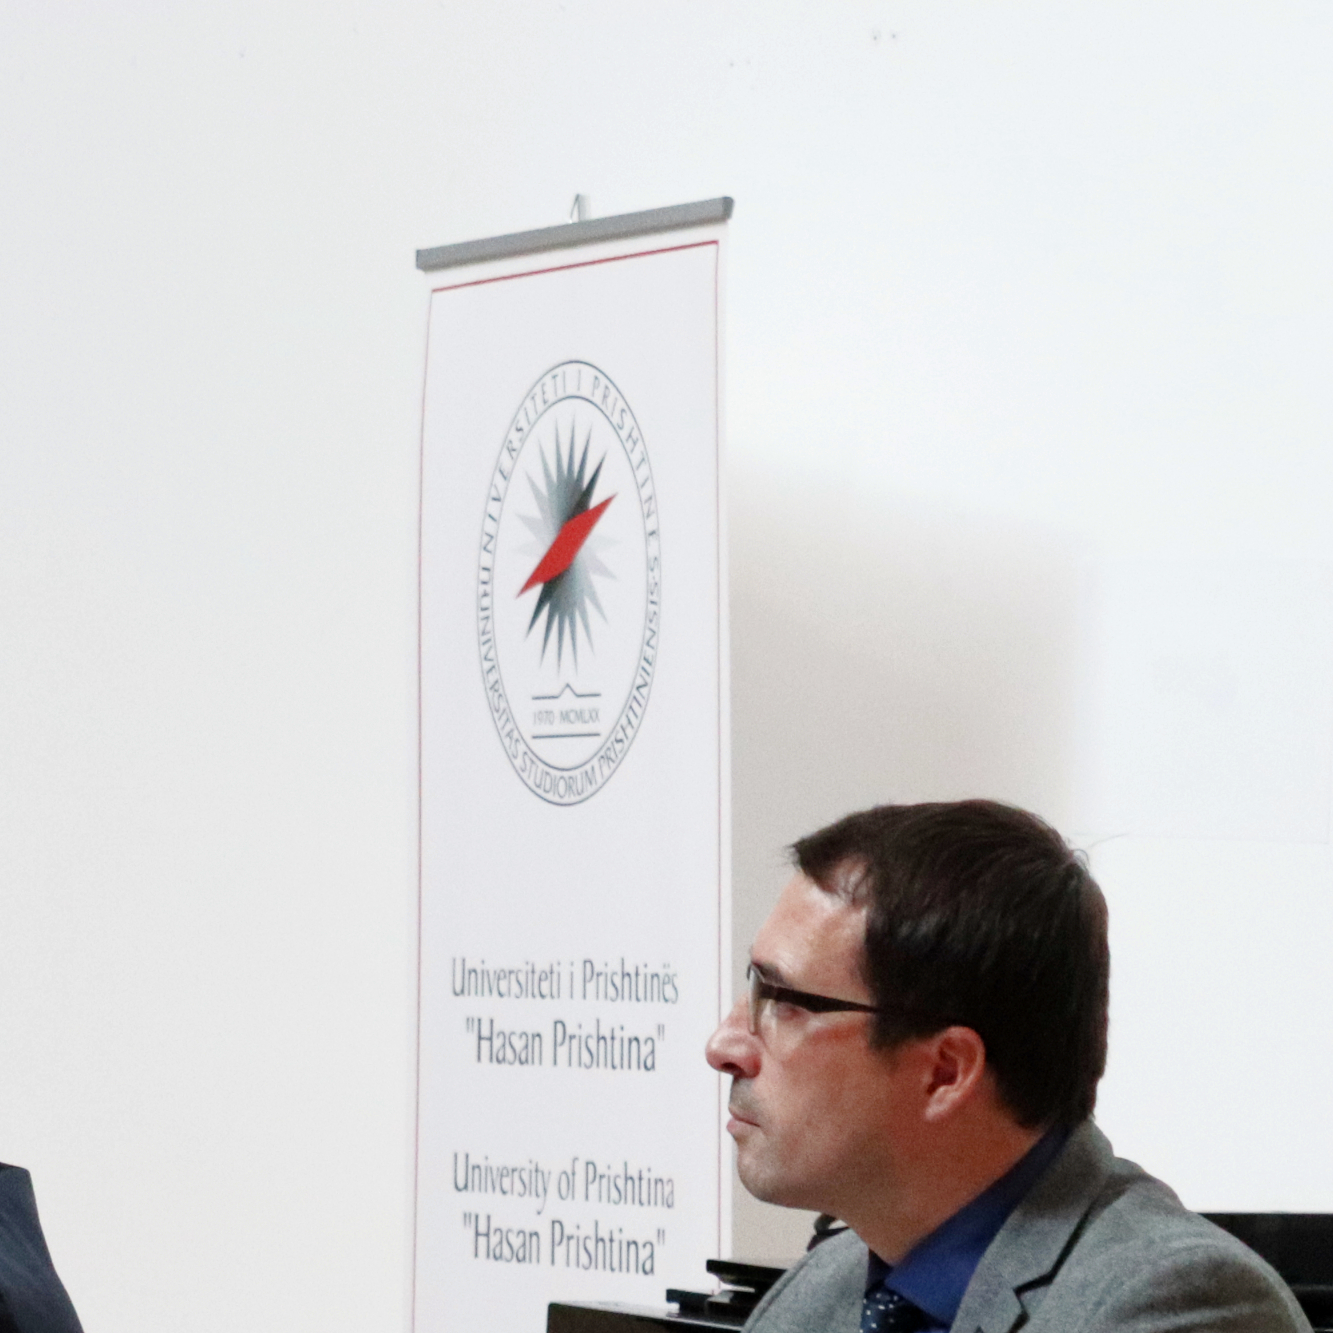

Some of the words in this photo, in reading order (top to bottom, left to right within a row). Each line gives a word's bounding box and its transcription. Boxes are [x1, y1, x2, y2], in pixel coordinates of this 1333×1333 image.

[519, 751, 598, 799] STUDIORUM
[452, 957, 562, 1000] Universiteti
[569, 961, 575, 1000] i
[582, 957, 679, 1005] Prishtinës
[466, 1016, 544, 1066] "Hasan
[552, 1018, 666, 1072] Prishtina"
[453, 1152, 552, 1216] University
[557, 1157, 579, 1201] of
[584, 1161, 675, 1209] Prishtina
[463, 1211, 541, 1265] "Hasan
[550, 1219, 666, 1275] Prishtina"
